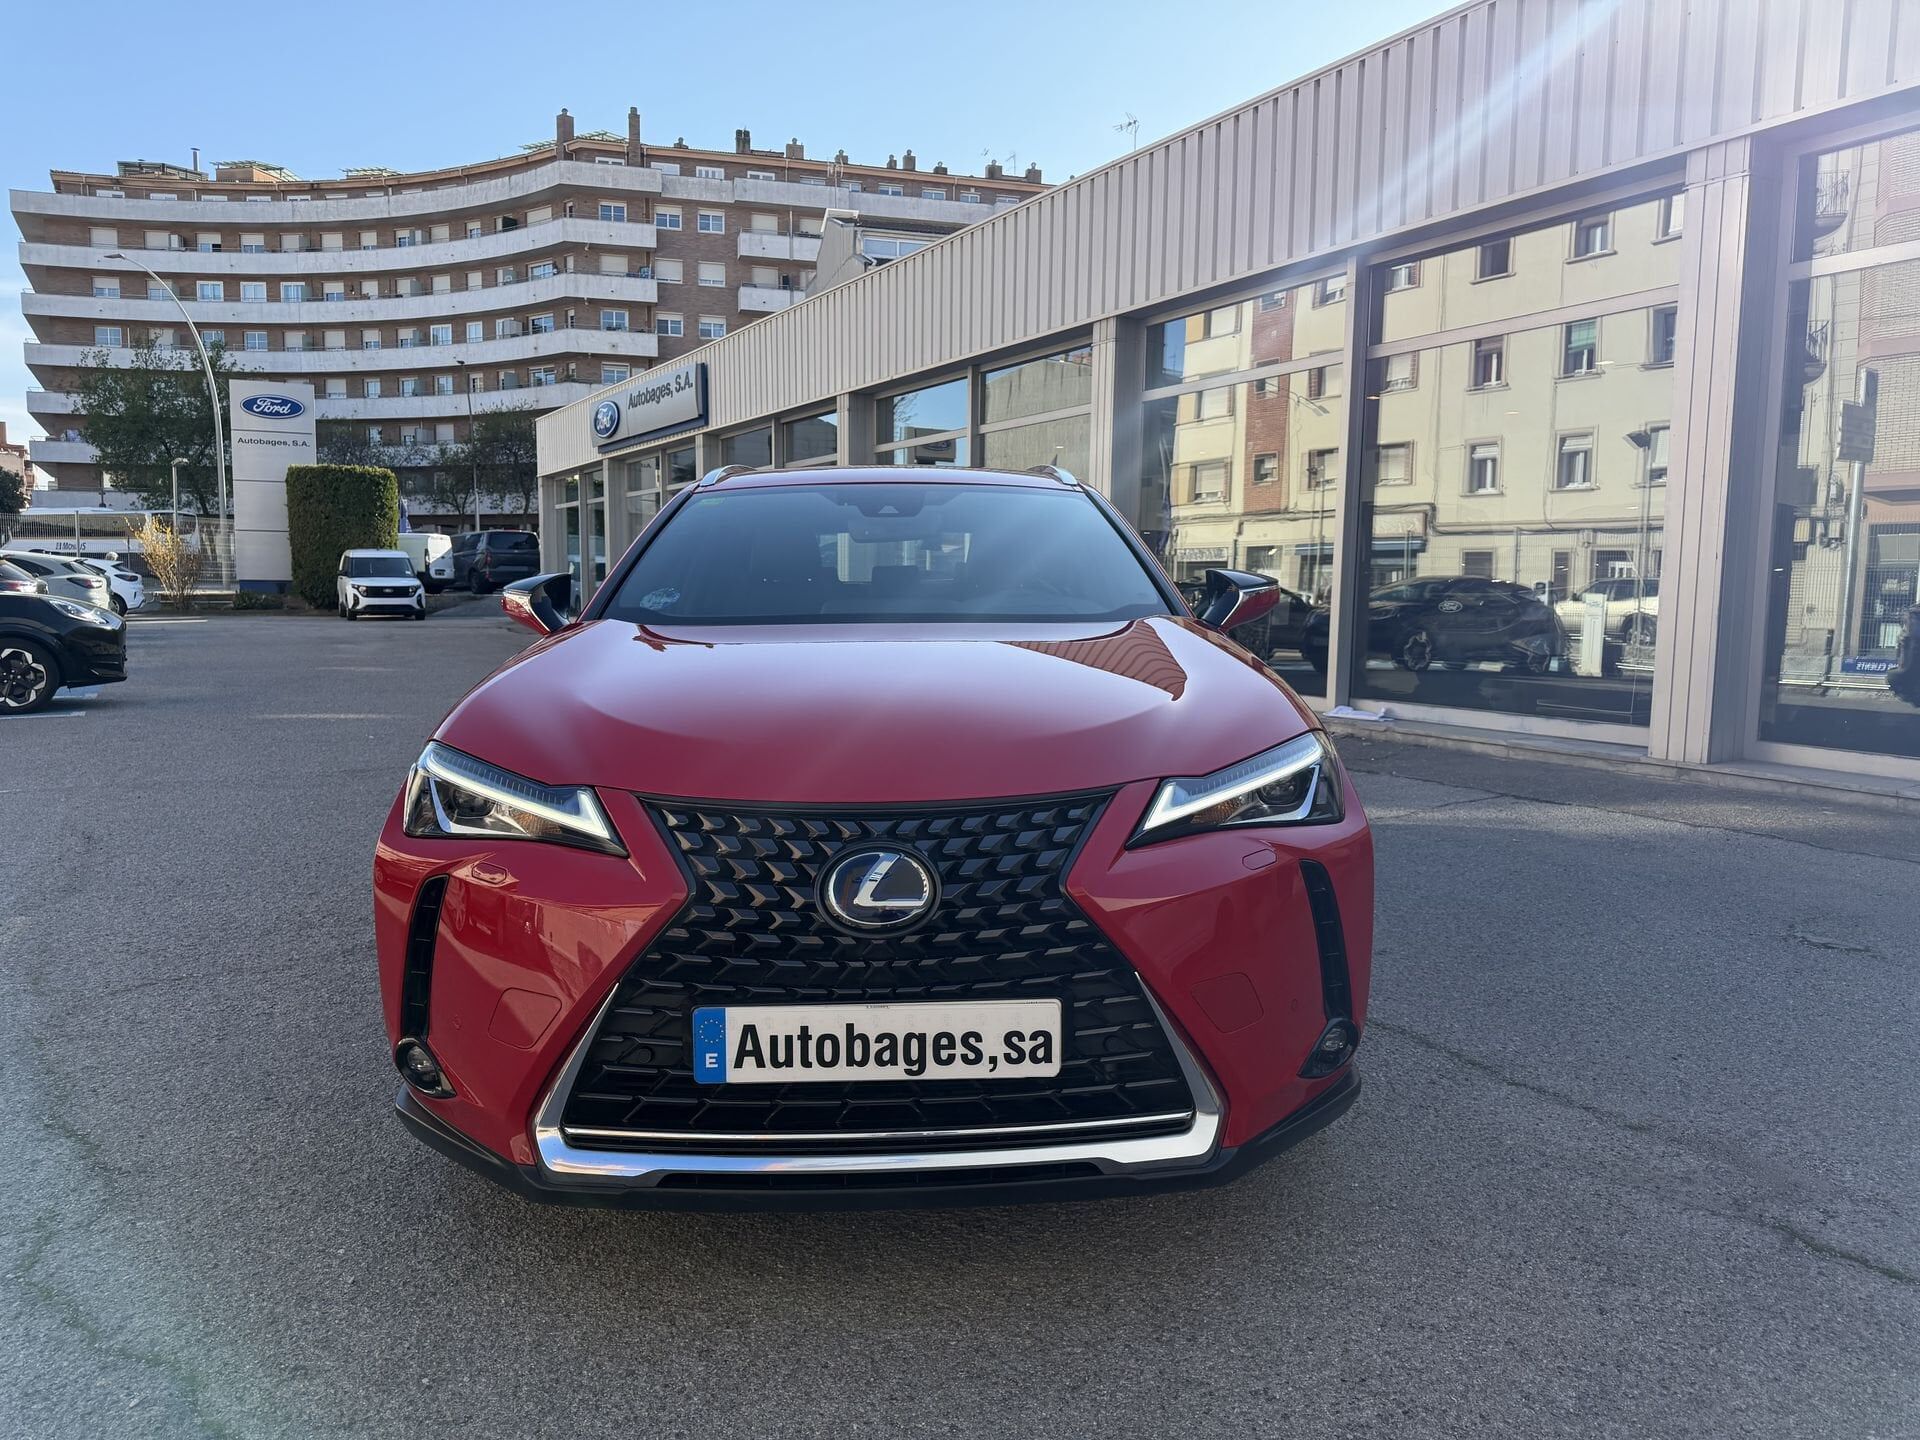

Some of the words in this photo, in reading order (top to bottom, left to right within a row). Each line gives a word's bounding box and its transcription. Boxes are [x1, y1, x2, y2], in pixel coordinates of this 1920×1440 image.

[627, 382, 674, 410] Autobages,
[674, 371, 694, 393] S.A.
[253, 397, 292, 415] Ford
[237, 437, 291, 447] Autobages,
[292, 440, 311, 448] S.A.
[733, 1022, 1054, 1077] Autobages,sa
[705, 1052, 719, 1068] E
